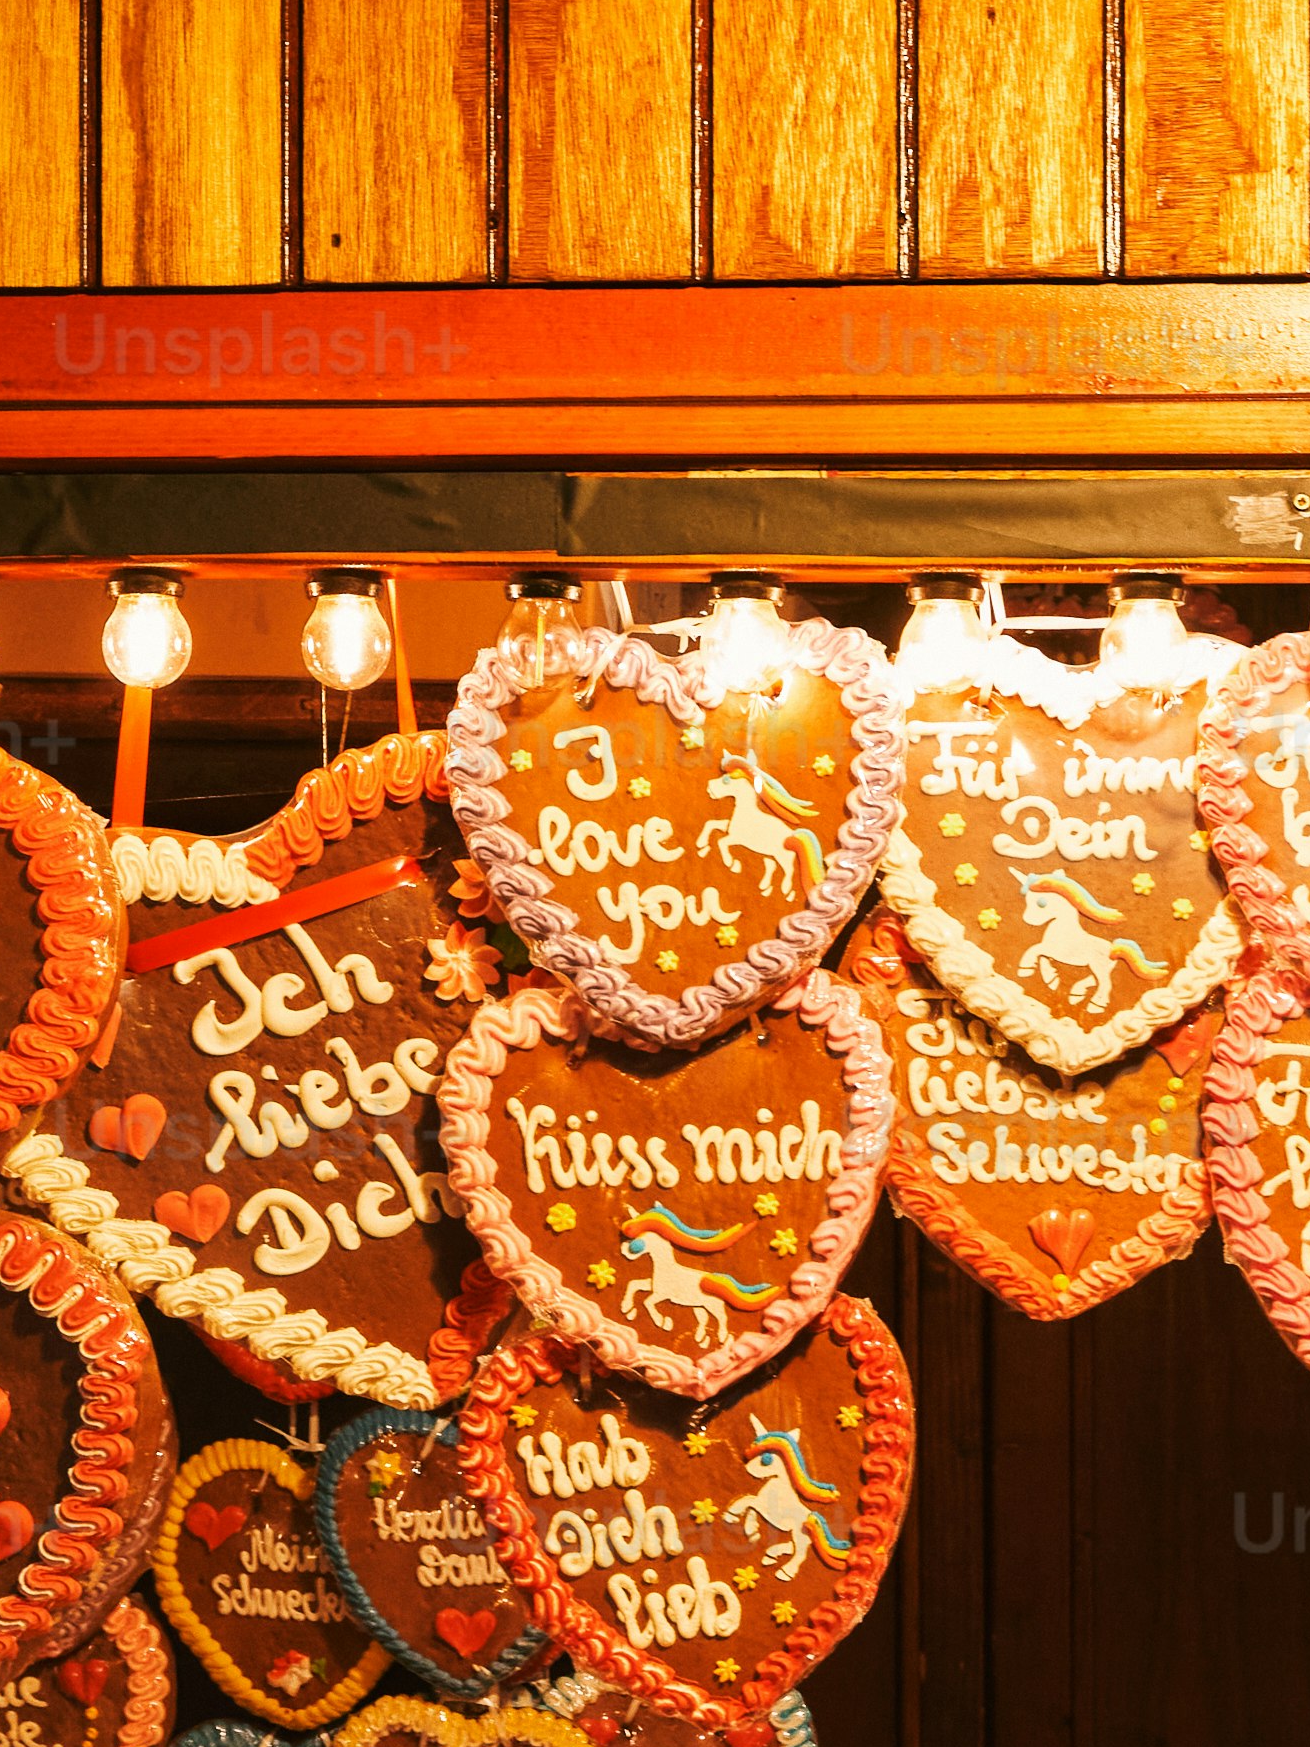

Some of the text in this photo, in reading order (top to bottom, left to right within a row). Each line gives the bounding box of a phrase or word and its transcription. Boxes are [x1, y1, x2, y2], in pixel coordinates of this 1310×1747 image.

[526, 805, 685, 877] love
[991, 794, 1159, 862] Dein
[597, 879, 741, 965] you
[207, 1036, 444, 1173] liebe
[681, 1099, 843, 1184] mich
[925, 1123, 1196, 1195] Schwester
[518, 1413, 655, 1501] Hab
[544, 1489, 684, 1578] Dich
